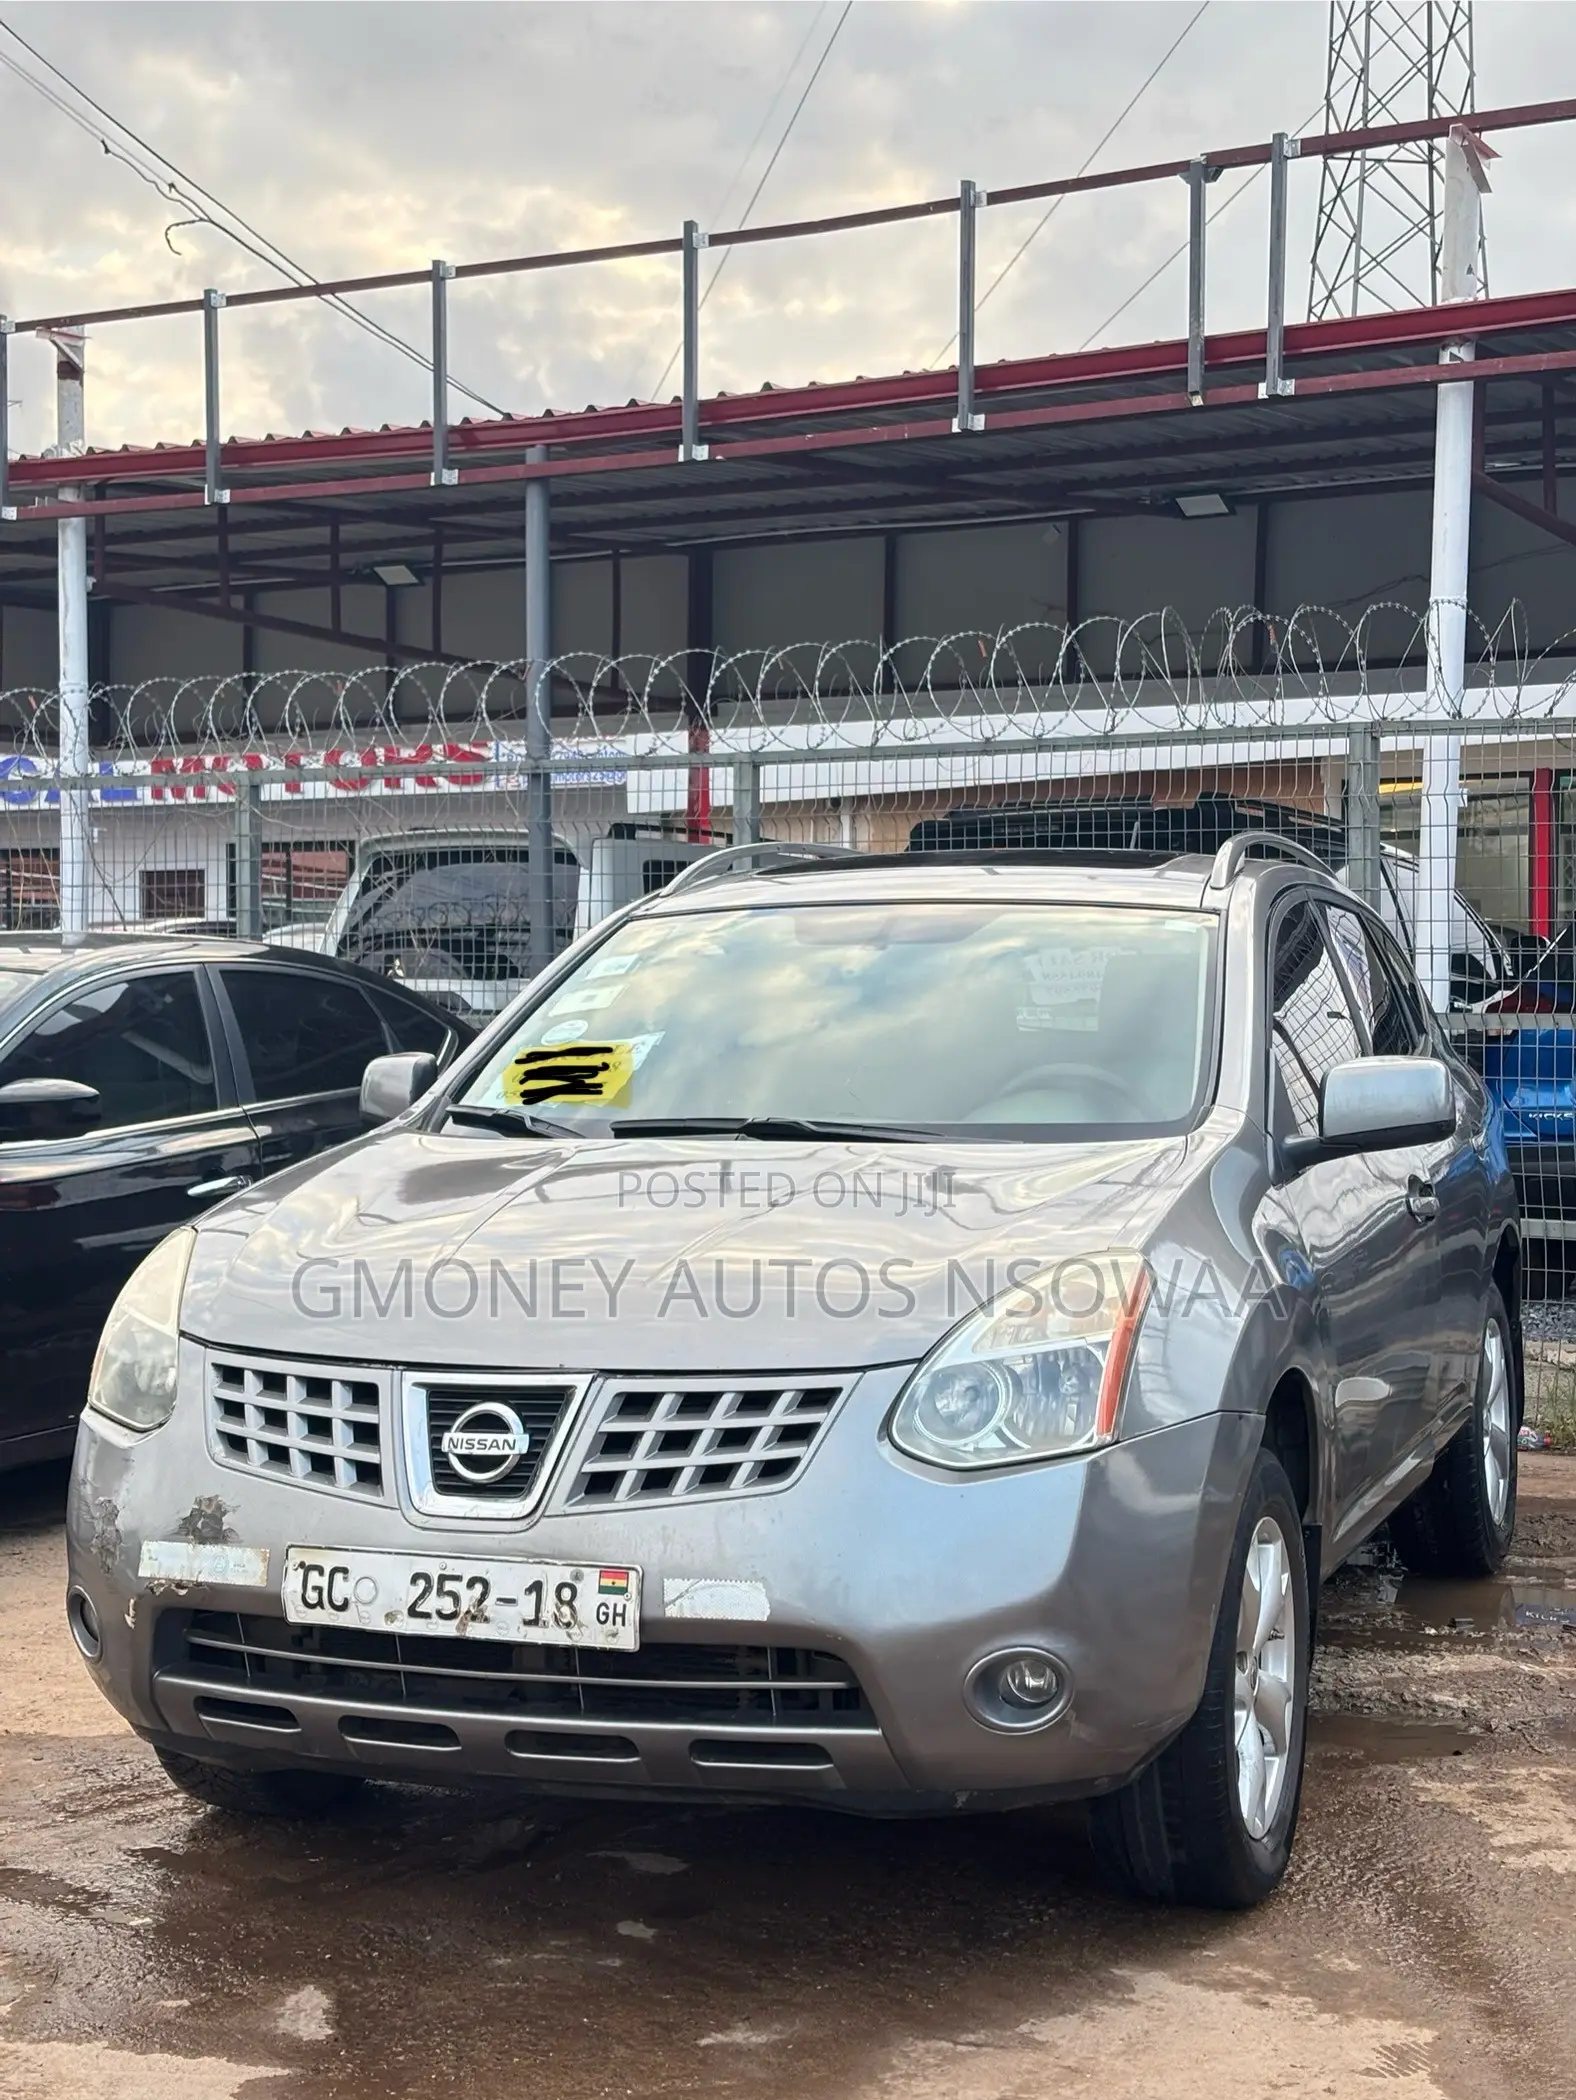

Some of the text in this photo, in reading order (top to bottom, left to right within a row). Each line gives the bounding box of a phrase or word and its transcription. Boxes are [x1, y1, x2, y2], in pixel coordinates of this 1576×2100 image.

[447, 1437, 517, 1451] NISSAN
[301, 1563, 579, 1630] GC 252-18
[596, 1602, 627, 1628] GH
